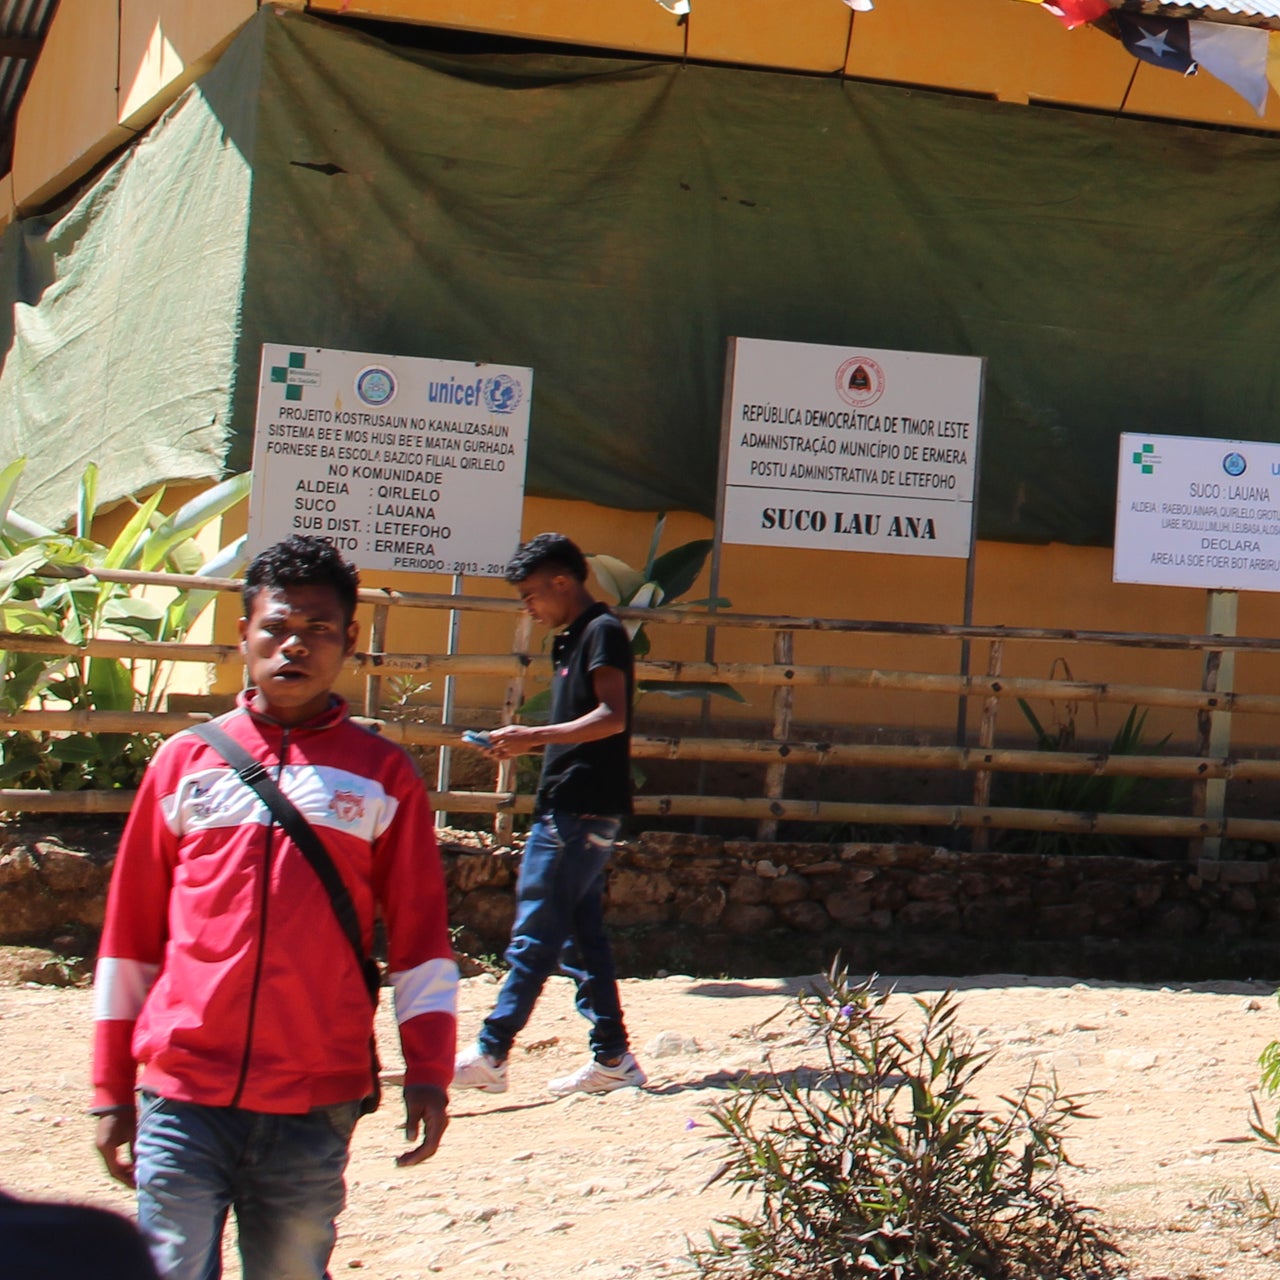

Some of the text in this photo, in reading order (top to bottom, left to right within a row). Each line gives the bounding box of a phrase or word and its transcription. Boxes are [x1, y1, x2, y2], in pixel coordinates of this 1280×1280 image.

[428, 376, 482, 406] unicef
[279, 406, 509, 438] PROJEITO KOSTRUSAUN NO KANALIZASAUN
[742, 402, 970, 439] REPÚBLICA DEMOCRÁTICA DE TIMOR LESTE
[268, 424, 515, 456] SISTEMA BE'E MOS HUSI BE'E MATAN GURHADA
[740, 433, 967, 464] ADMINISTRAÇÃO MUNICÍPIO DE ERMERA
[266, 442, 506, 472] FORNESE BA ESCOLA BAZICO FILIAL QIRLELO
[328, 464, 443, 484] NO KOMUNIDADE
[750, 460, 956, 490] POSTU ADMINISTRATIVA DE LETEFOHO
[296, 480, 350, 495] ALDEIA
[378, 485, 440, 502] QIRLELO
[1190, 482, 1220, 499] SUCO
[1228, 485, 1270, 502] LAUANA
[294, 497, 336, 512] SUCO
[376, 504, 436, 520] LAUANA
[1130, 501, 1156, 512] ALDEIA
[292, 516, 322, 530] SUB
[328, 518, 362, 532] DIST.
[375, 522, 452, 539] LETEFOHO
[762, 507, 936, 540] SUCO LAU ANA
[375, 540, 435, 556] ERMERA
[1201, 538, 1261, 552] DECLARA
[394, 557, 444, 570] PERIODO
[454, 562, 478, 572] 2013
[488, 564, 508, 574] 201
[1150, 552, 1174, 565] AREA
[1175, 554, 1186, 566] LA
[1187, 554, 1205, 567] SOE
[1206, 555, 1230, 568] FOER
[1231, 556, 1248, 570] BOT
[1249, 558, 1280, 572] ARBIRU
